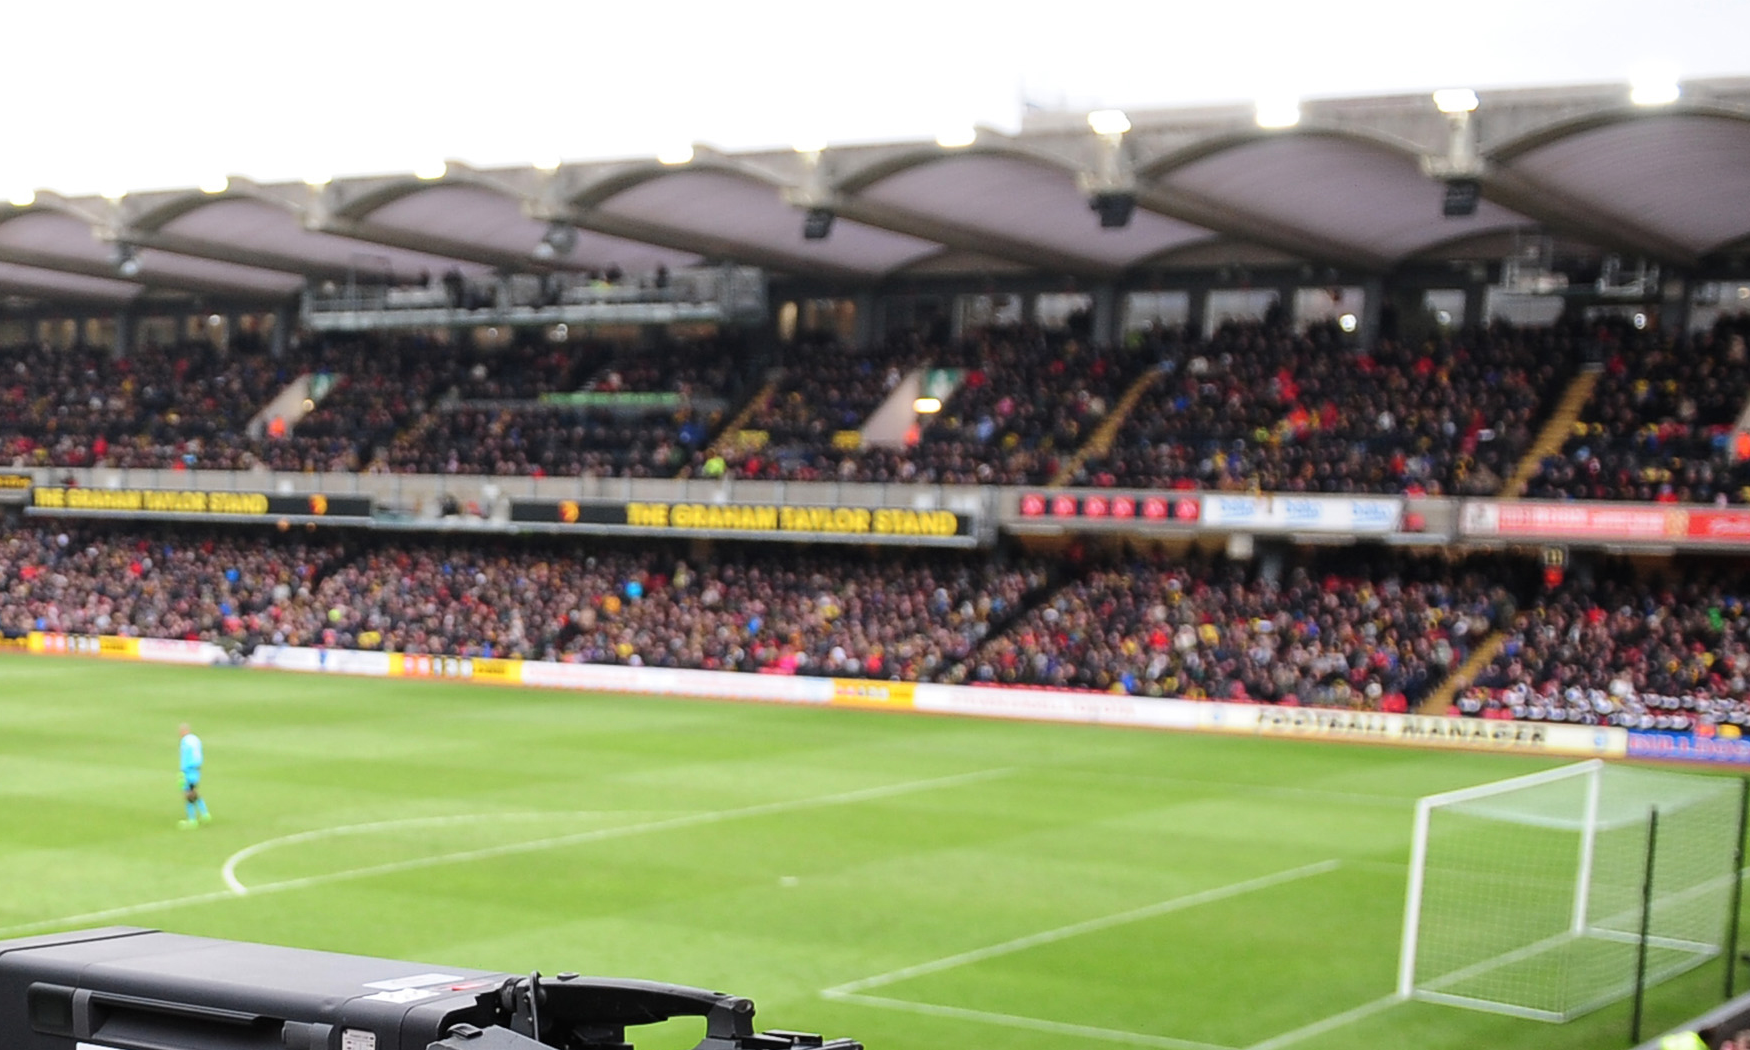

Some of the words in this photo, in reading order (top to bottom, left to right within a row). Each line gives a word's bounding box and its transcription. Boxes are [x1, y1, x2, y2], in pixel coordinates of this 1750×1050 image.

[626, 502, 669, 526] THE
[670, 503, 778, 530] GRAHAM
[779, 506, 871, 534] TAYLOR
[872, 508, 958, 536] STAND
[1402, 716, 1547, 746] MANAGER
